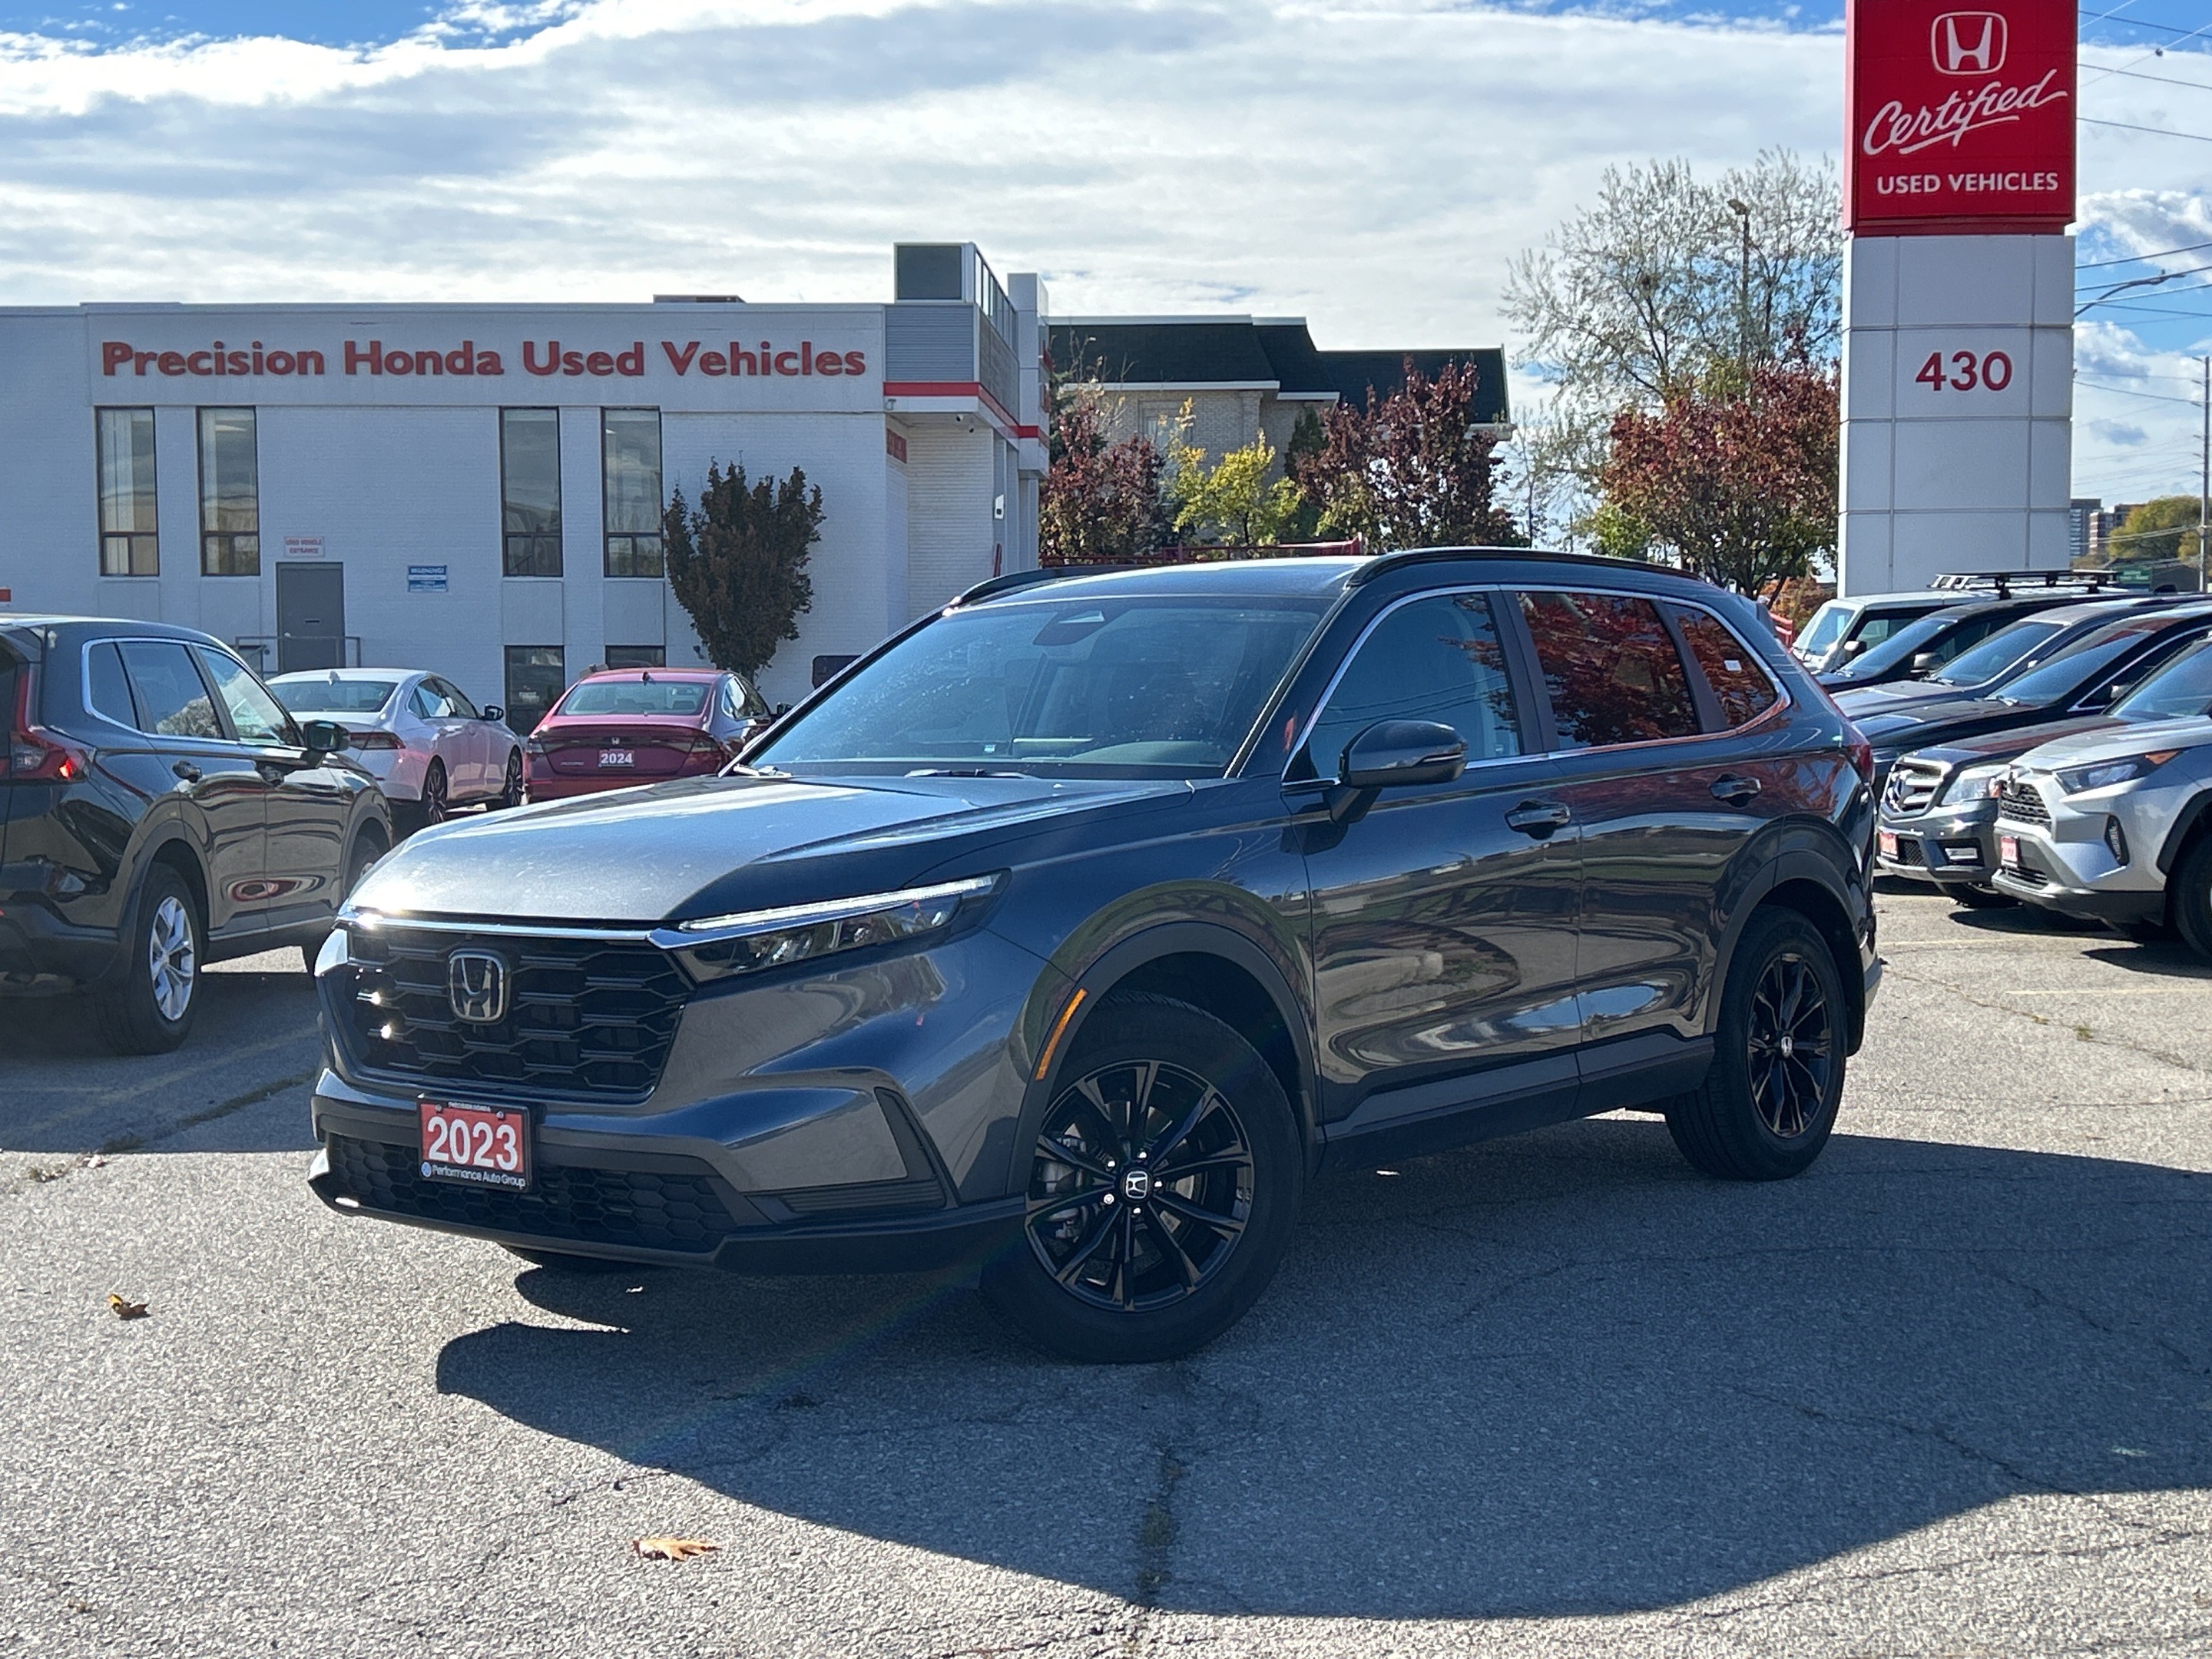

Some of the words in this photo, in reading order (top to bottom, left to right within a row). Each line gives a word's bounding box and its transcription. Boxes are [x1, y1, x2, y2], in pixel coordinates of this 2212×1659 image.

[1863, 68, 2068, 154] Certified
[1876, 174, 1941, 194] USED
[1947, 172, 2058, 191] VEHICLES
[102, 340, 325, 376] Precision
[344, 339, 505, 376] Honda
[522, 341, 644, 376] Used
[661, 341, 866, 376] Vehicles
[1915, 350, 2012, 391] 430
[601, 753, 633, 764] 2024
[427, 1116, 518, 1171] 2023
[432, 1164, 482, 1182] Performance
[482, 1171, 501, 1184] Auto
[501, 1173, 526, 1190] Group
